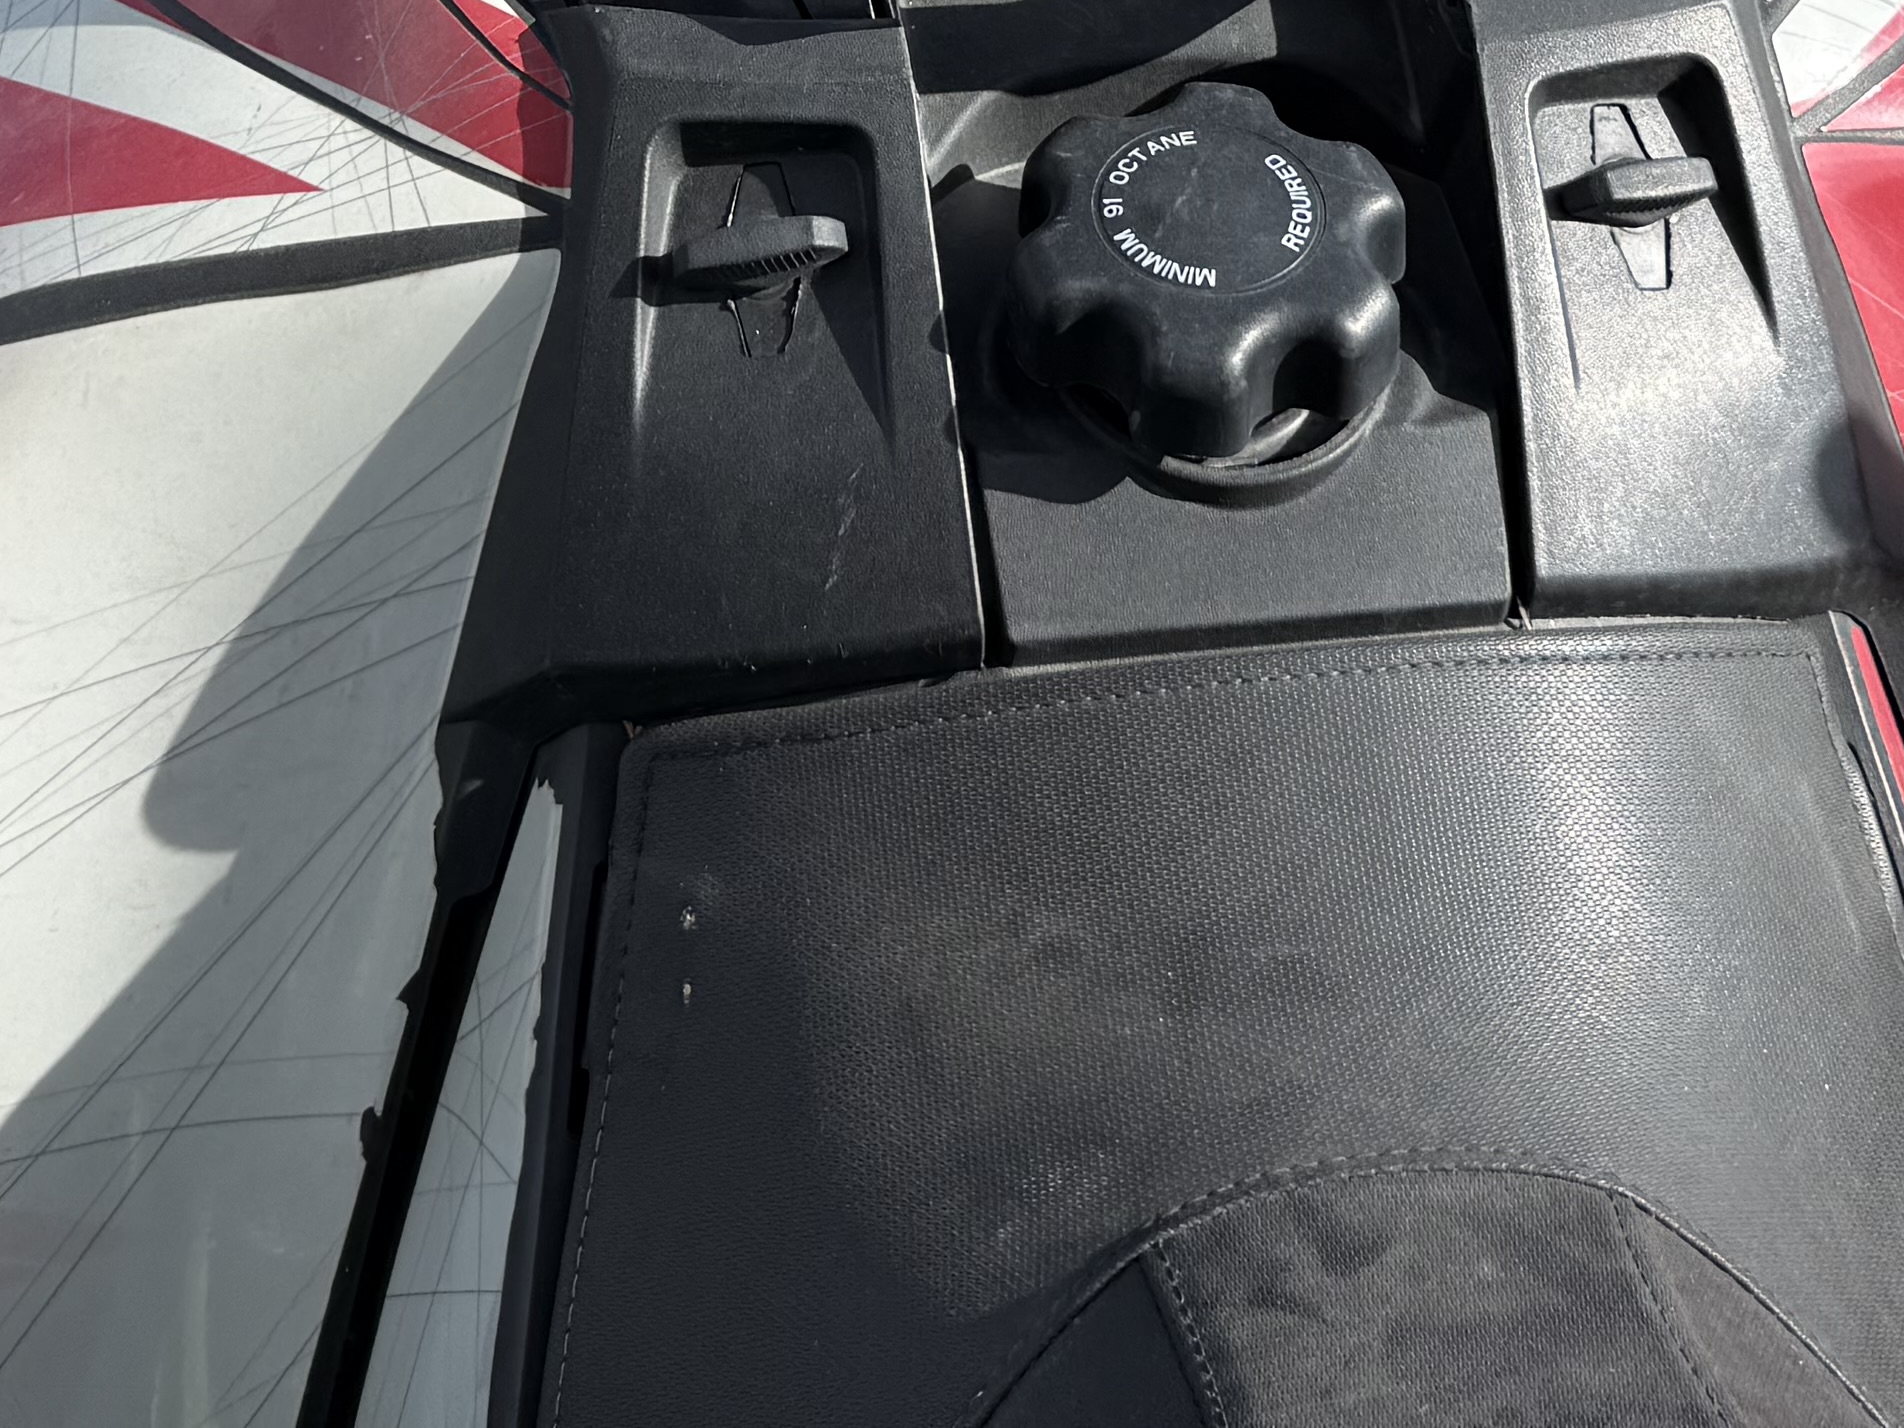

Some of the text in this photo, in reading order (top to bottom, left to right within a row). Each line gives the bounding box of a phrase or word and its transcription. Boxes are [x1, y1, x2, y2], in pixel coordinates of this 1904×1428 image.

[1102, 130, 1312, 287] MINIMUM 91 OCTANE REQUIRED
